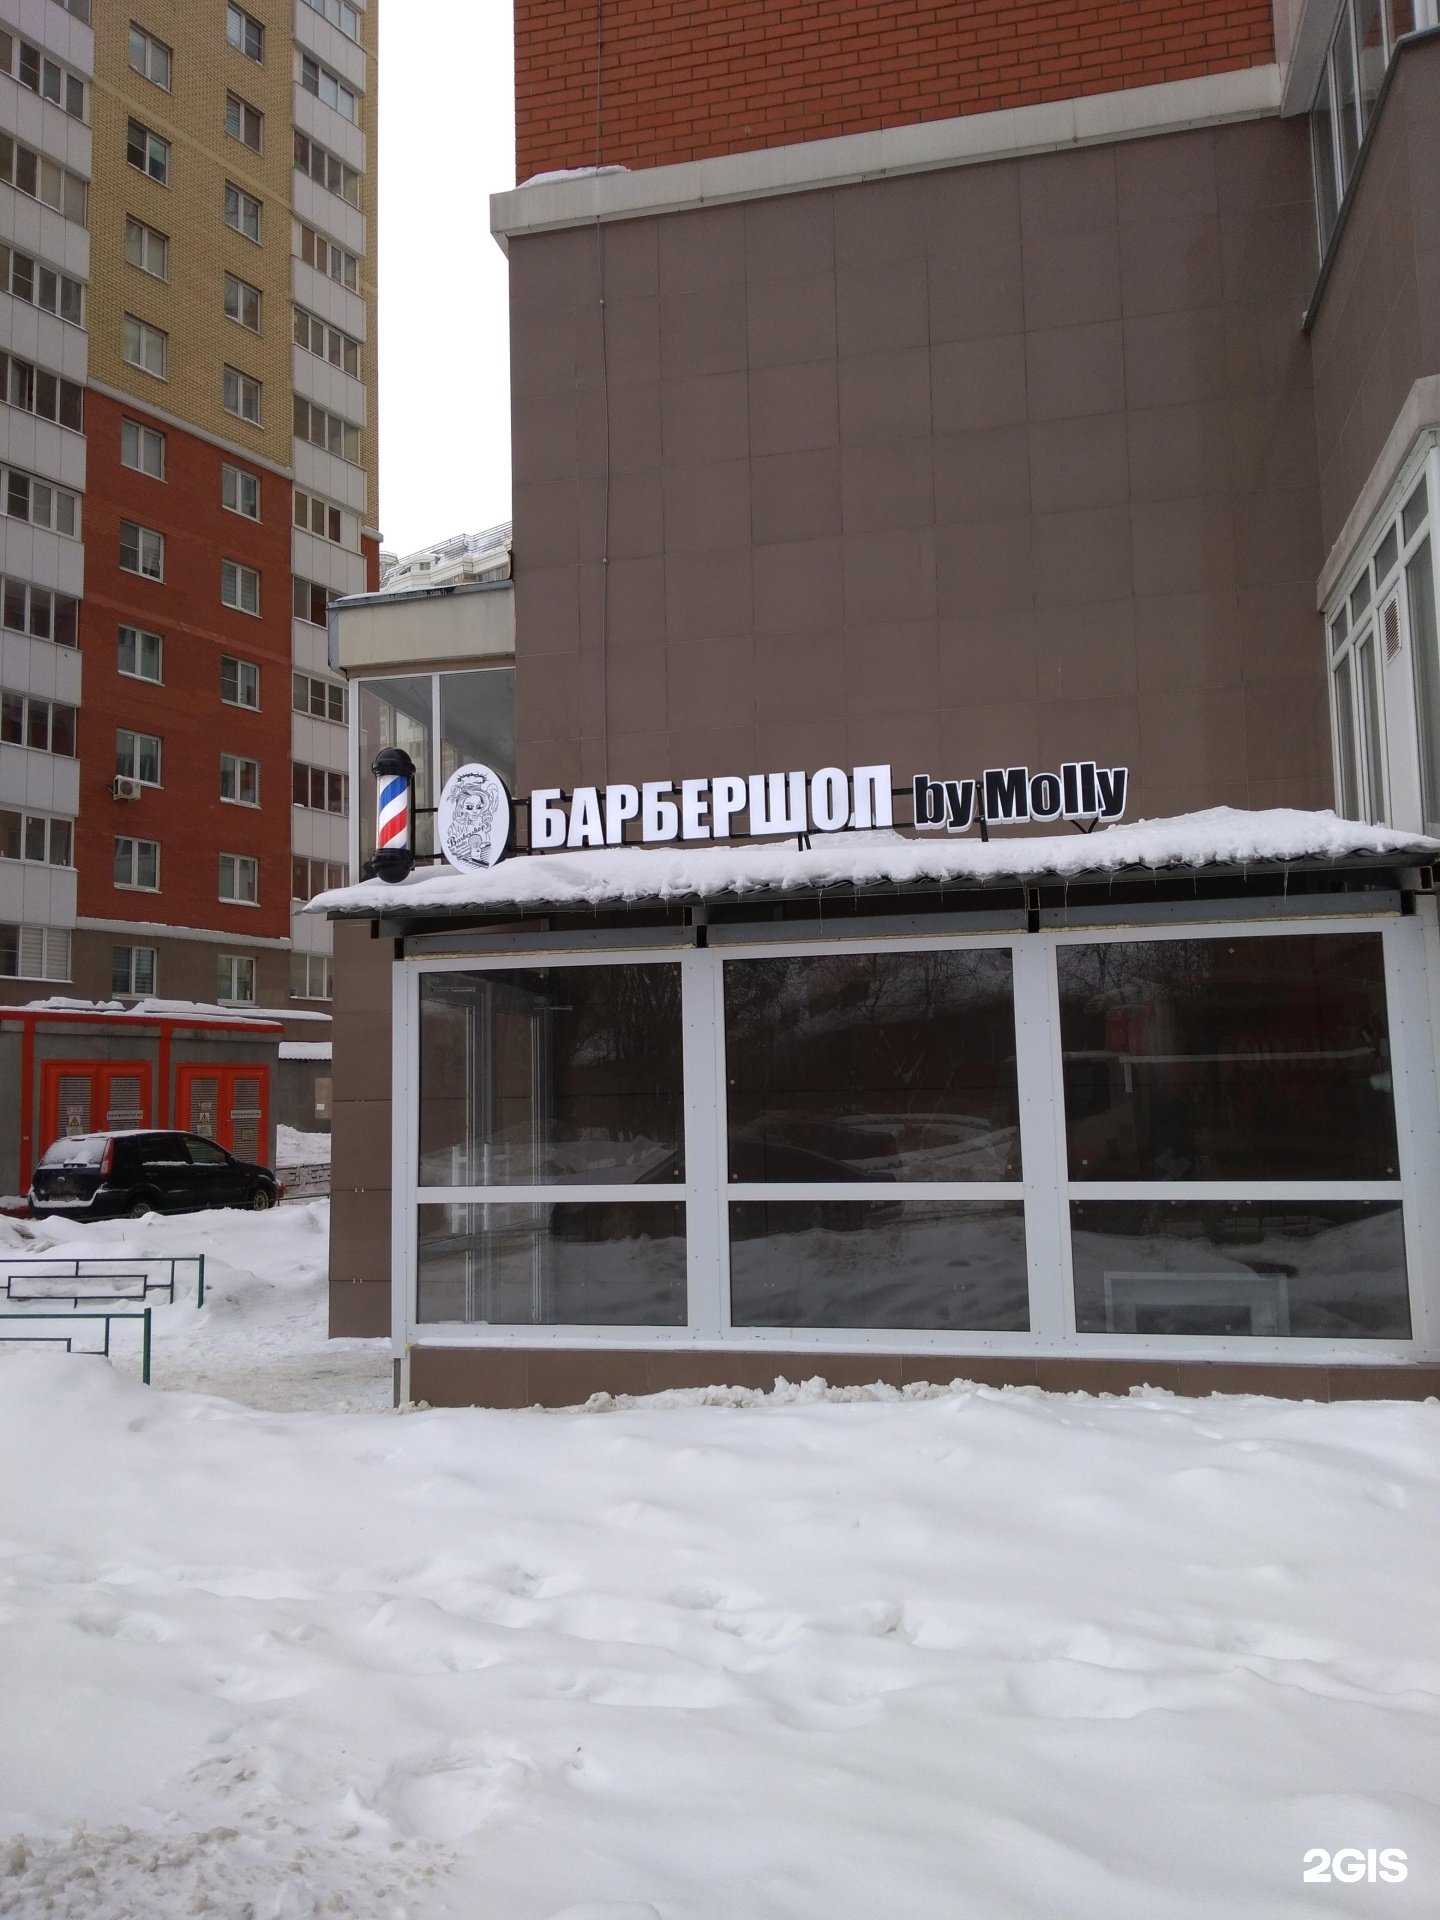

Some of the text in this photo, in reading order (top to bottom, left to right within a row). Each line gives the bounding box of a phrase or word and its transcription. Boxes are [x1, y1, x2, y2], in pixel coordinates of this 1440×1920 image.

[531, 764, 892, 849] БАРБЕРШОП
[913, 762, 1127, 833] by Molly
